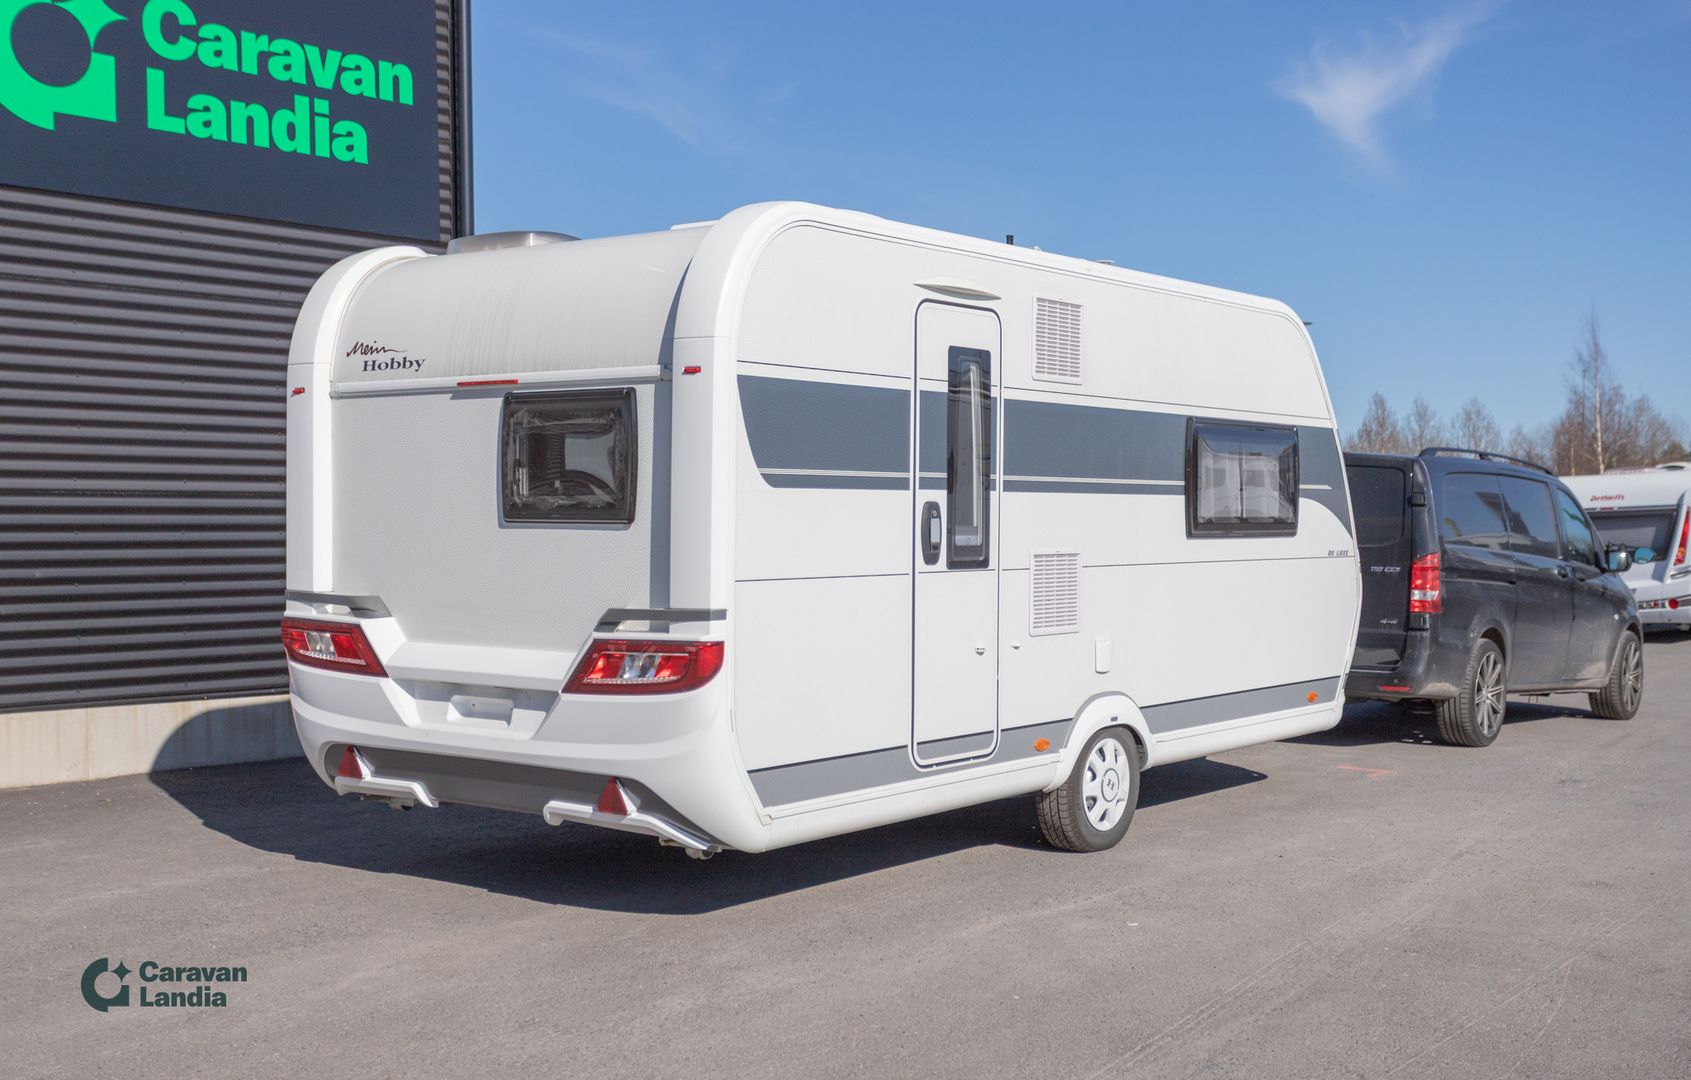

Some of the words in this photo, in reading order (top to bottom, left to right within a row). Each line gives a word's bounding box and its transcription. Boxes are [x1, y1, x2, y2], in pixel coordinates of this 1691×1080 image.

[142, 0, 413, 106] Caravan
[146, 67, 369, 165] Landia
[347, 340, 407, 357] Mein
[362, 356, 426, 372] Hobby
